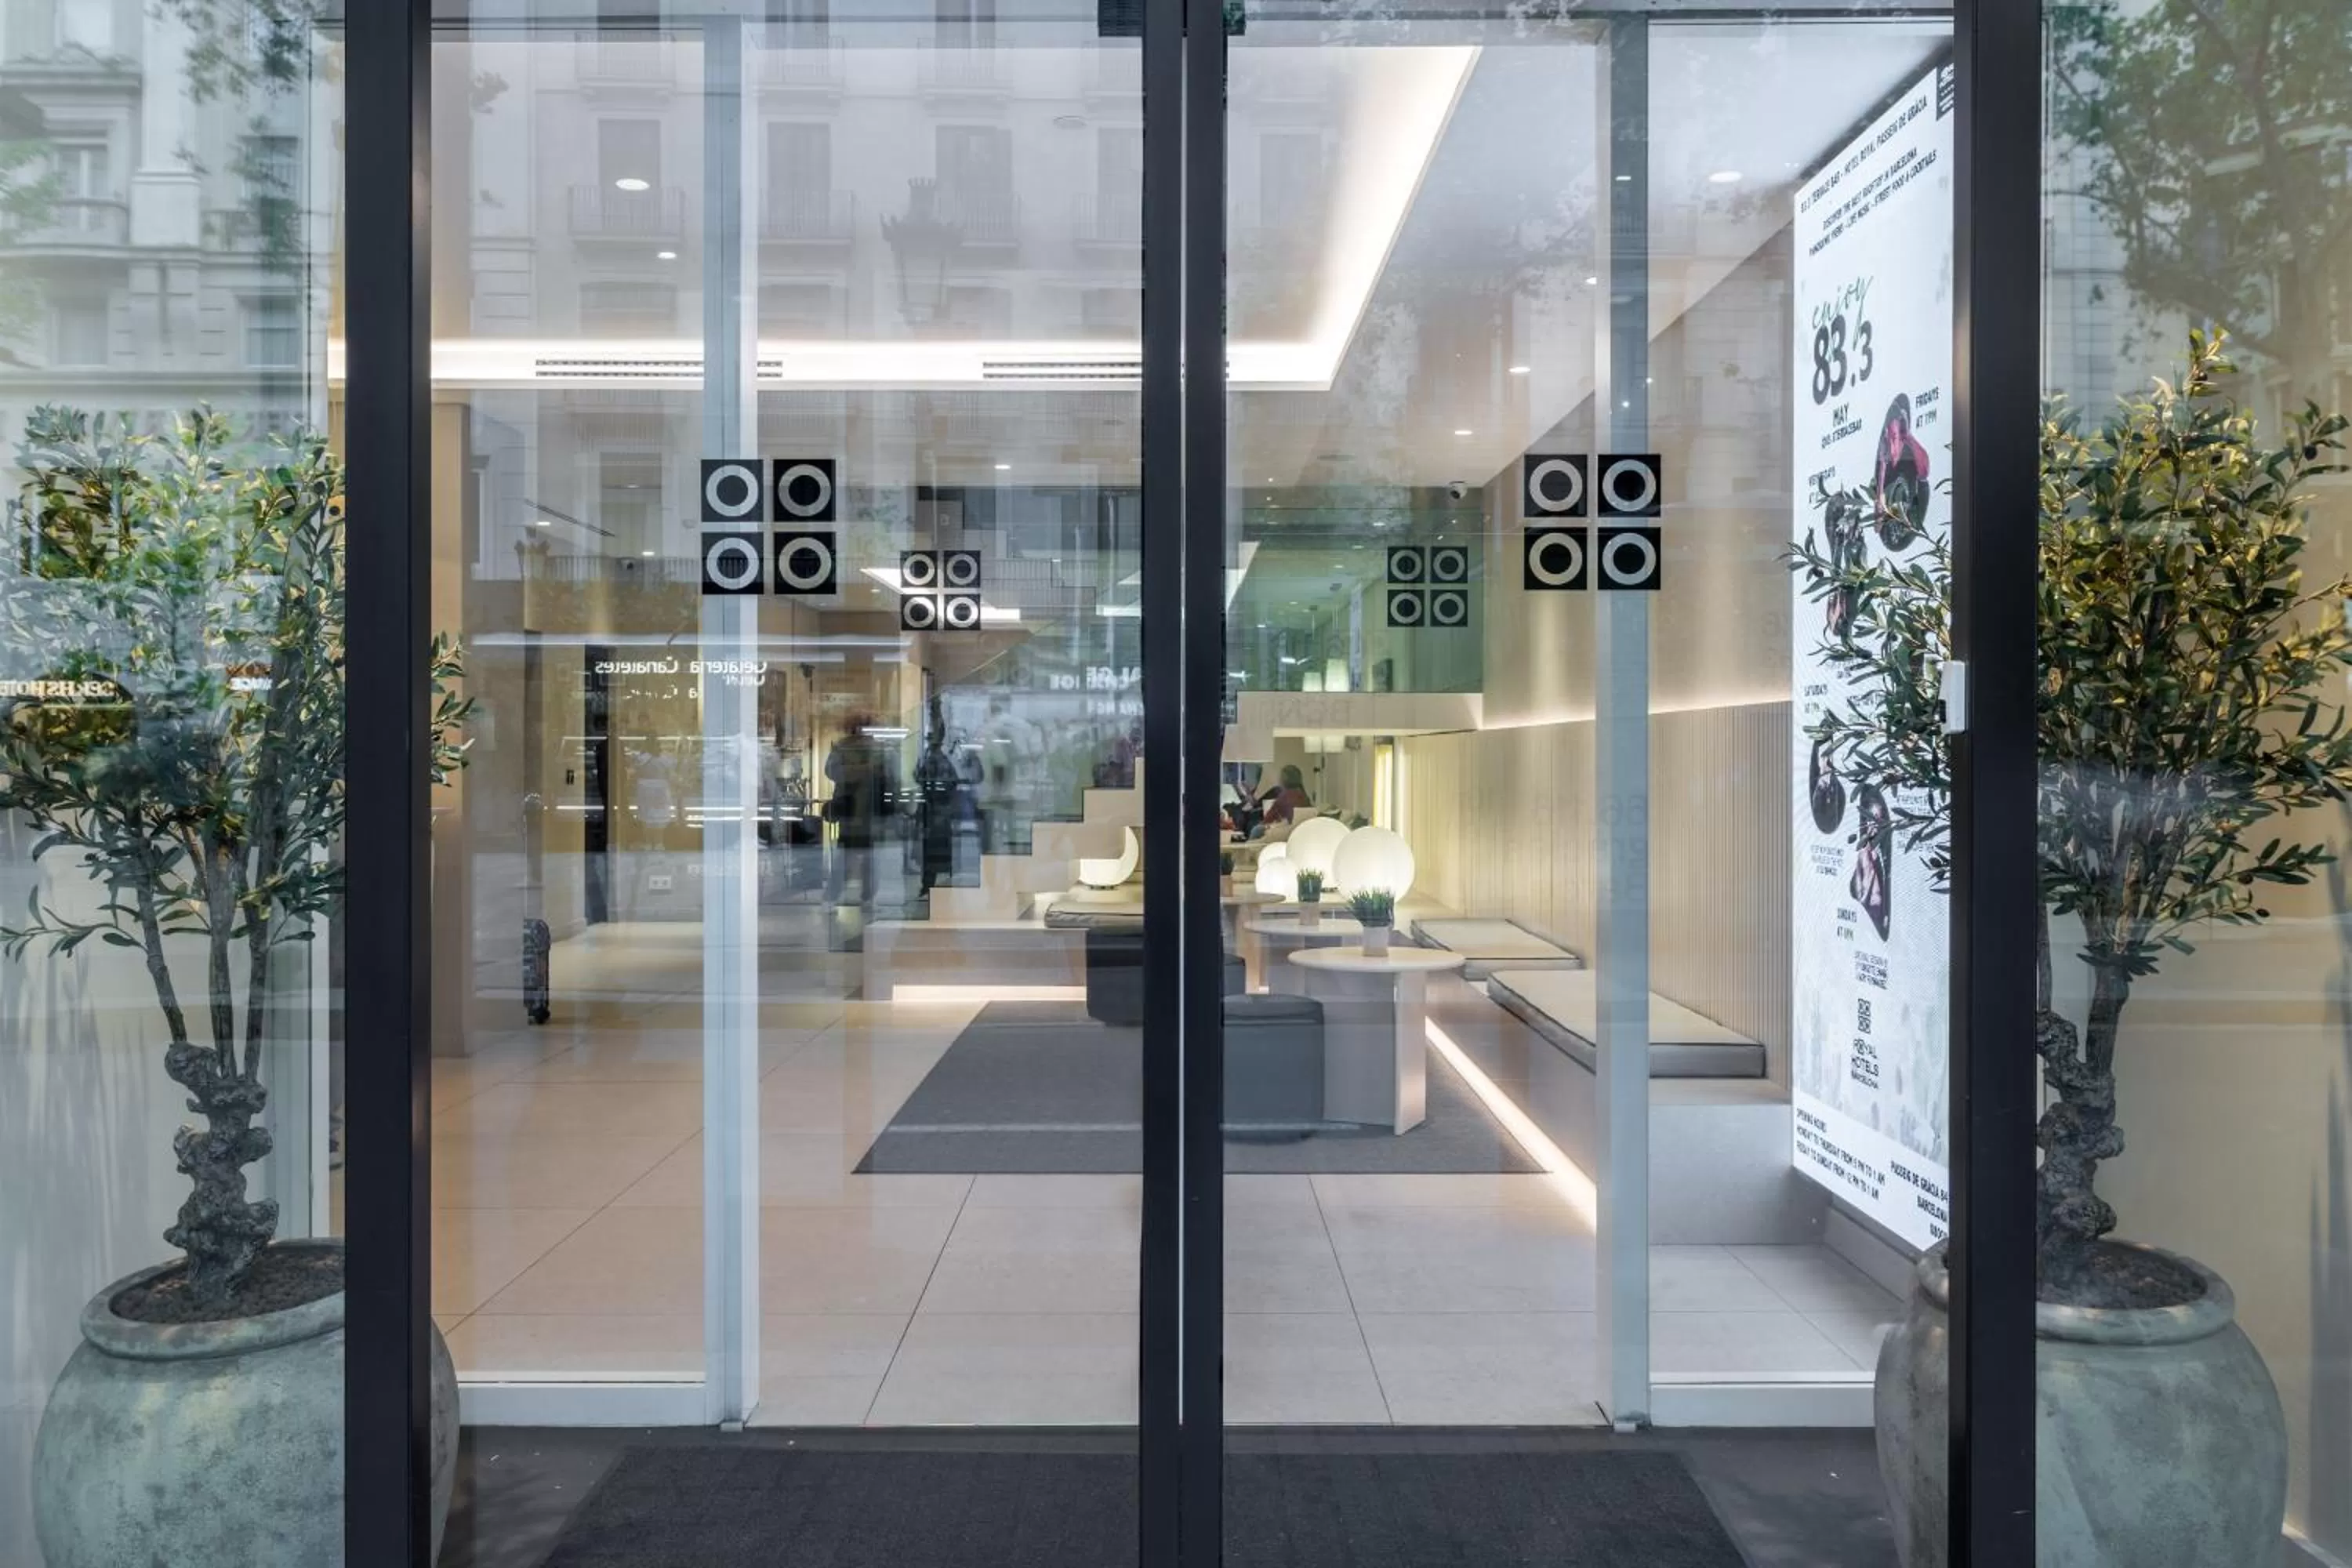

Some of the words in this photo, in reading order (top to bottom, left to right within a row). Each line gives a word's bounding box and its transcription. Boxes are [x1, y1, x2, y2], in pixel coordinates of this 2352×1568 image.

[1899, 112, 1907, 129] DE
[1813, 314, 1873, 405] 83.3
[1833, 402, 1849, 427] MAY
[1911, 1171, 1920, 1189] DE
